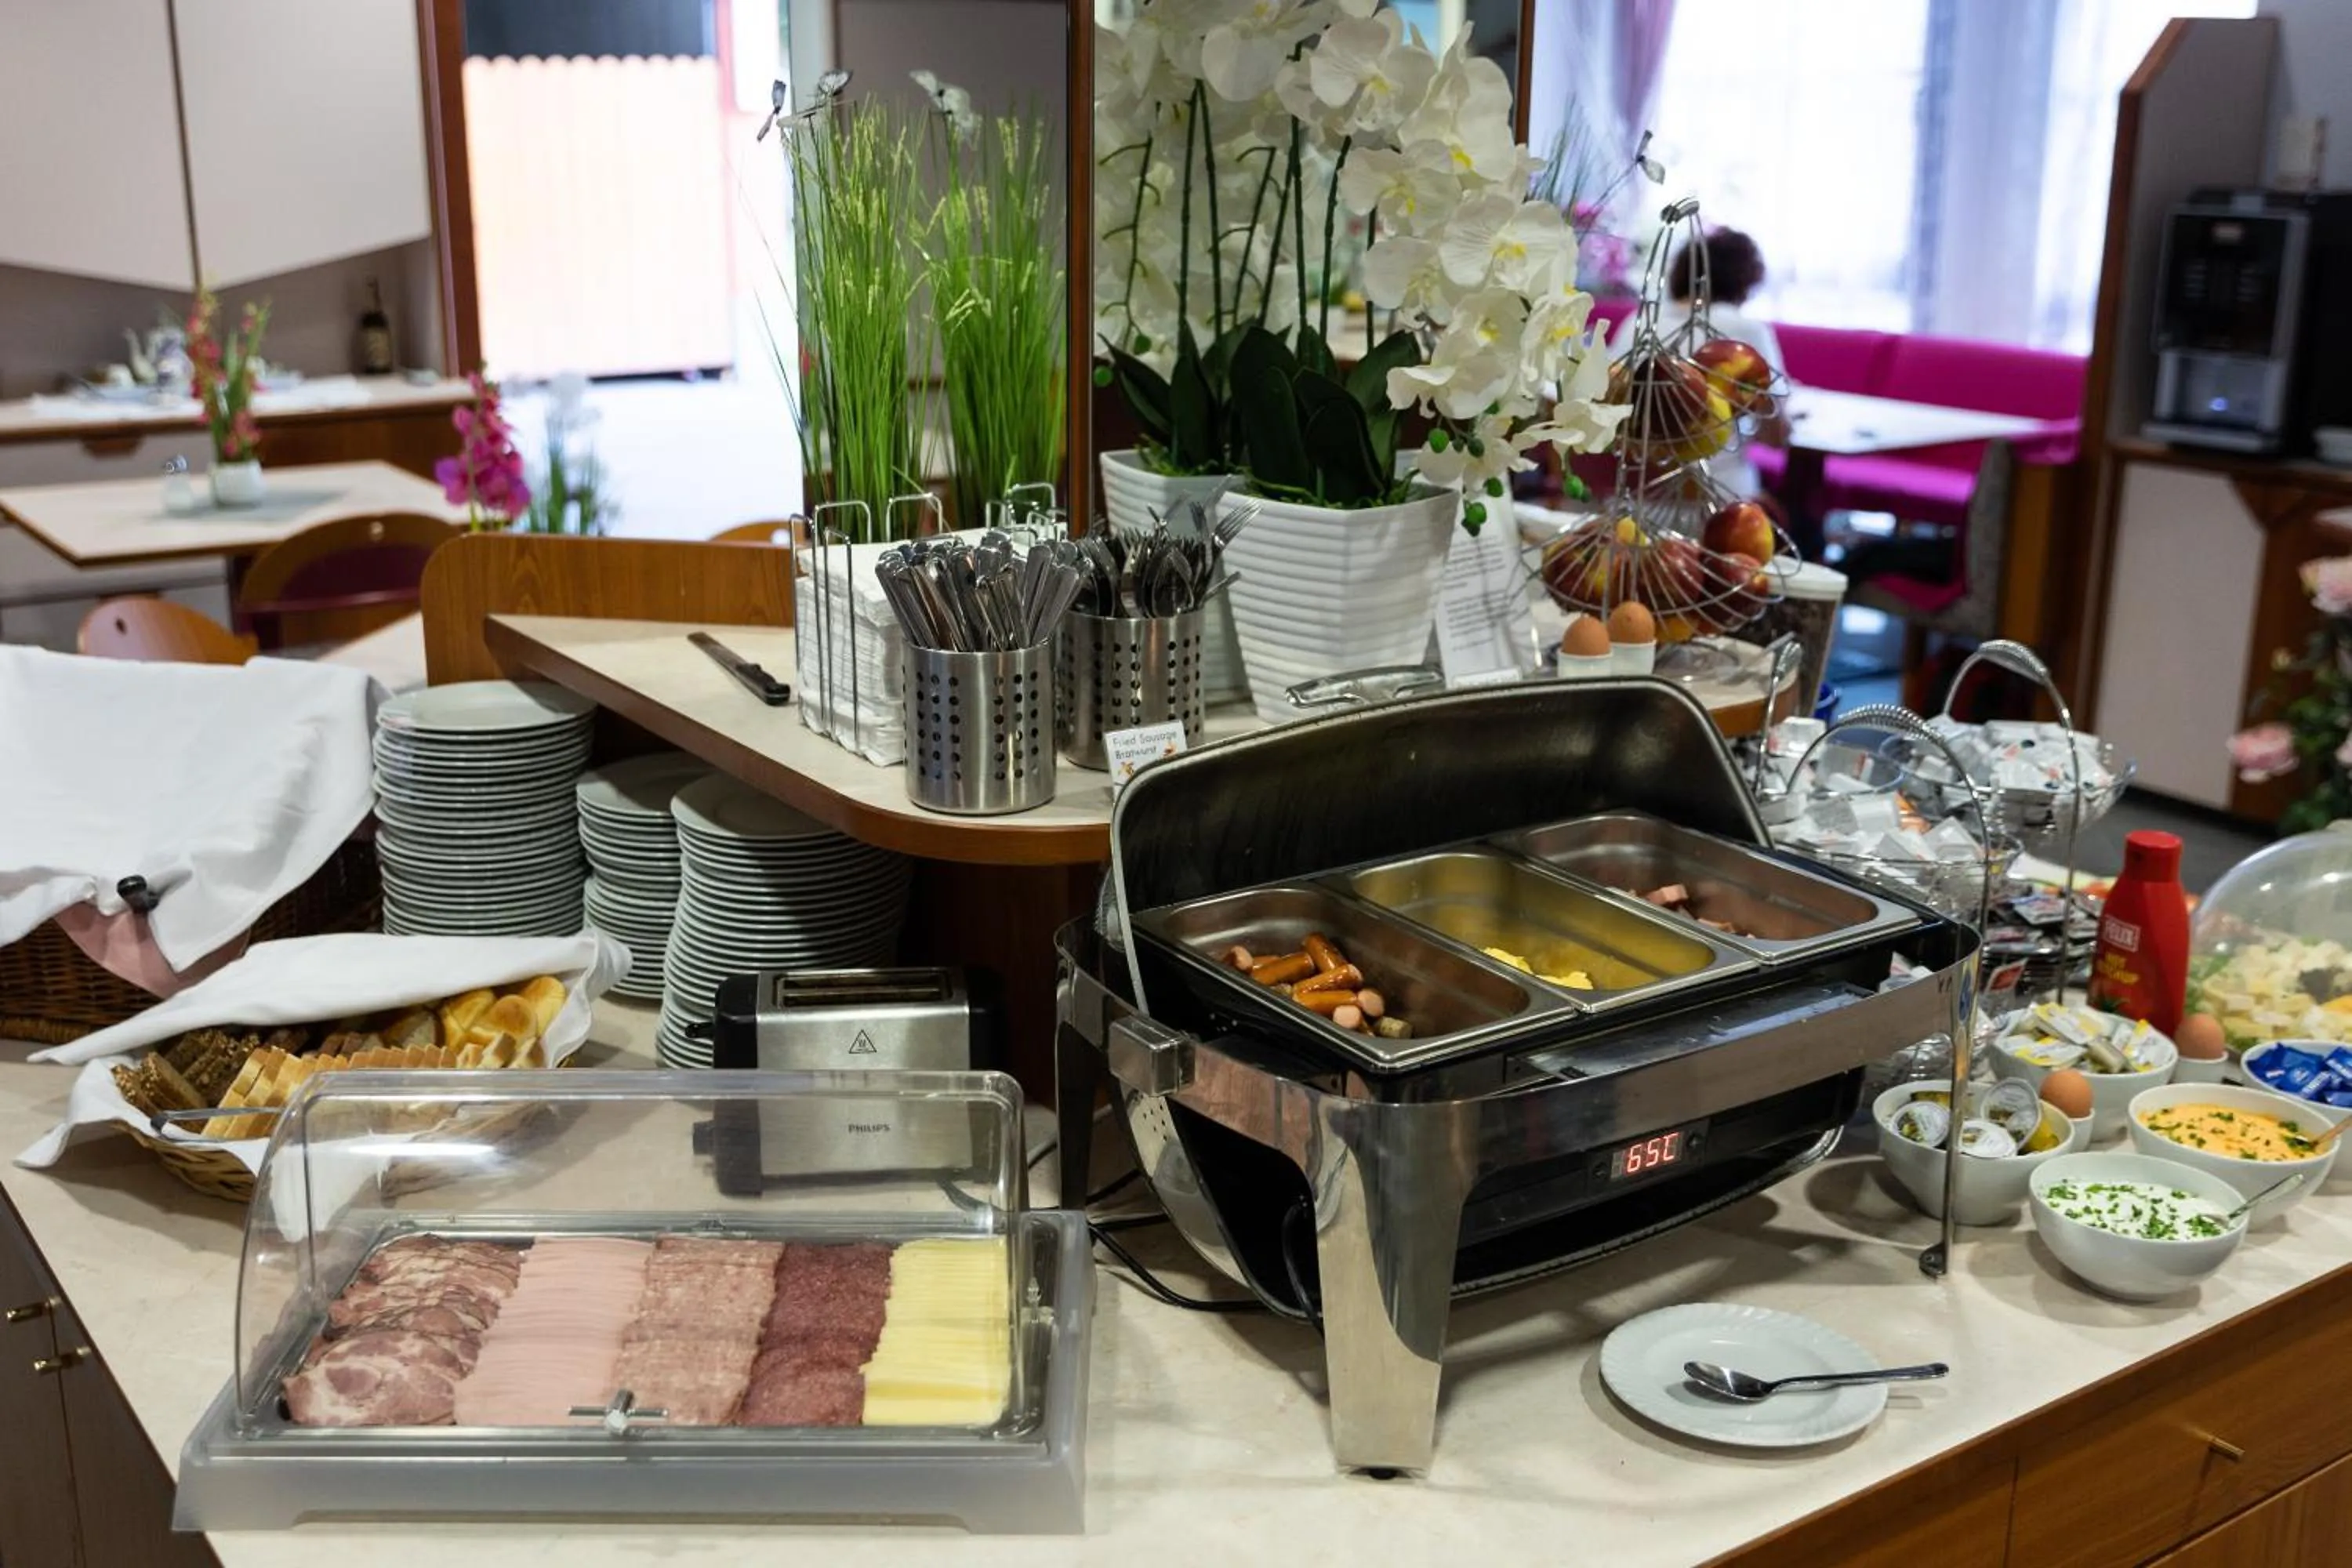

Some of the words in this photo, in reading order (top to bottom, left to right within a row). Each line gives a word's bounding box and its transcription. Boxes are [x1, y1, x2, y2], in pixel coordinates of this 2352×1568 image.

[1112, 736, 1136, 746] Fried
[848, 1123, 891, 1134] PHILIPS
[1627, 1132, 1679, 1173] 65C
